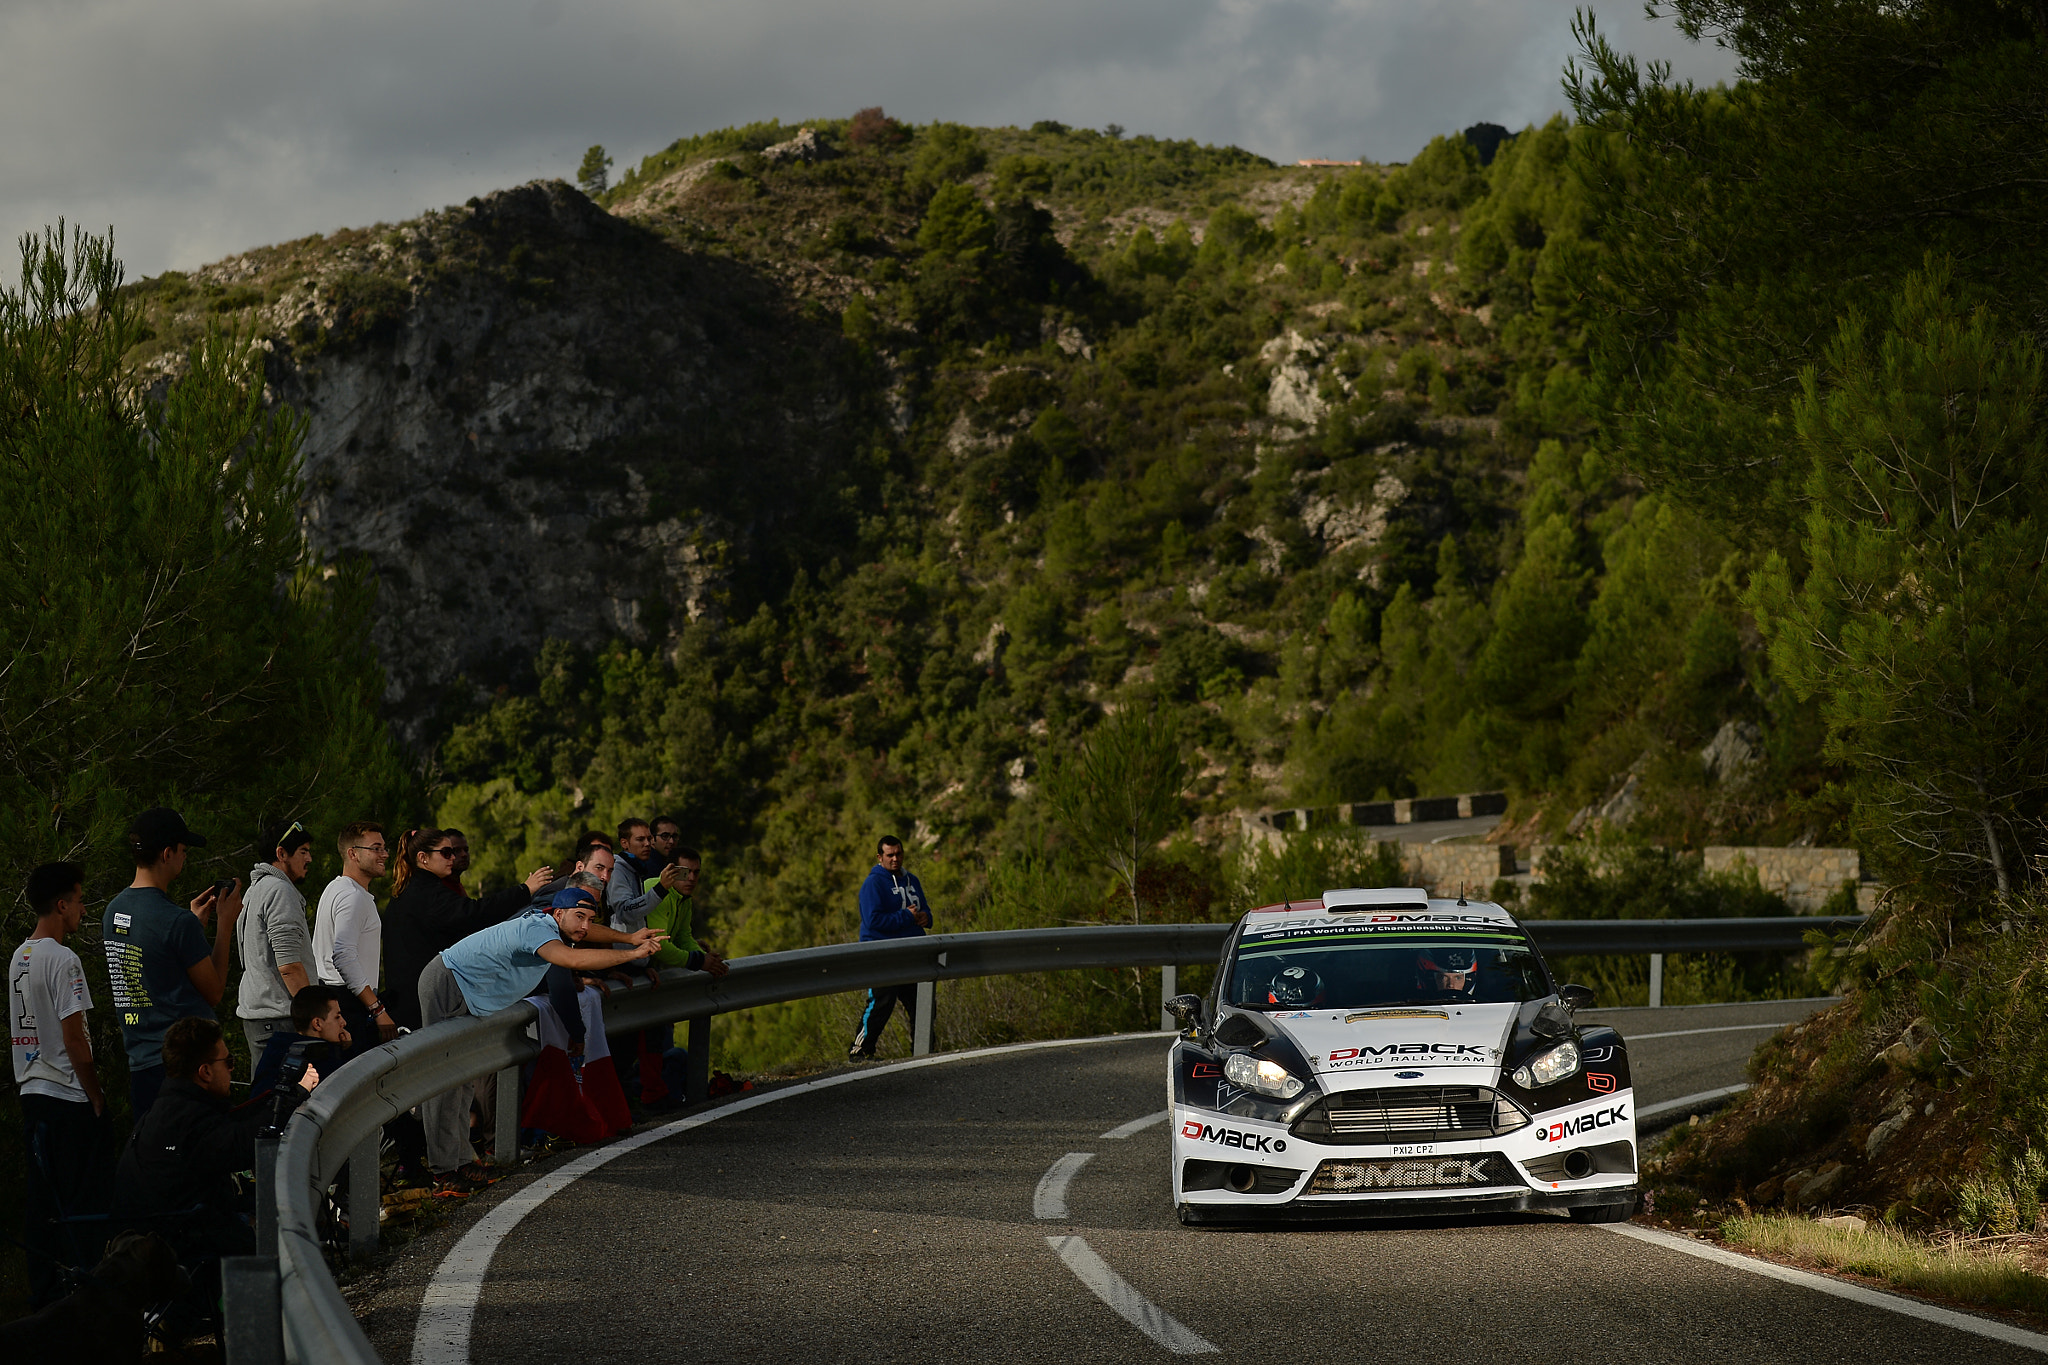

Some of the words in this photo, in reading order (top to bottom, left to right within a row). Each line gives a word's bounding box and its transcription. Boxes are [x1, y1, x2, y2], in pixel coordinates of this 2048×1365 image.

[1313, 927, 1345, 935] World
[1329, 1043, 1487, 1061] DMACK
[1329, 1057, 1383, 1068] WORLD
[1391, 1055, 1436, 1063] RALLY
[1548, 1104, 1629, 1142] DMACK
[1181, 1120, 1273, 1153] DMACK
[1333, 1158, 1491, 1190] DMACK
